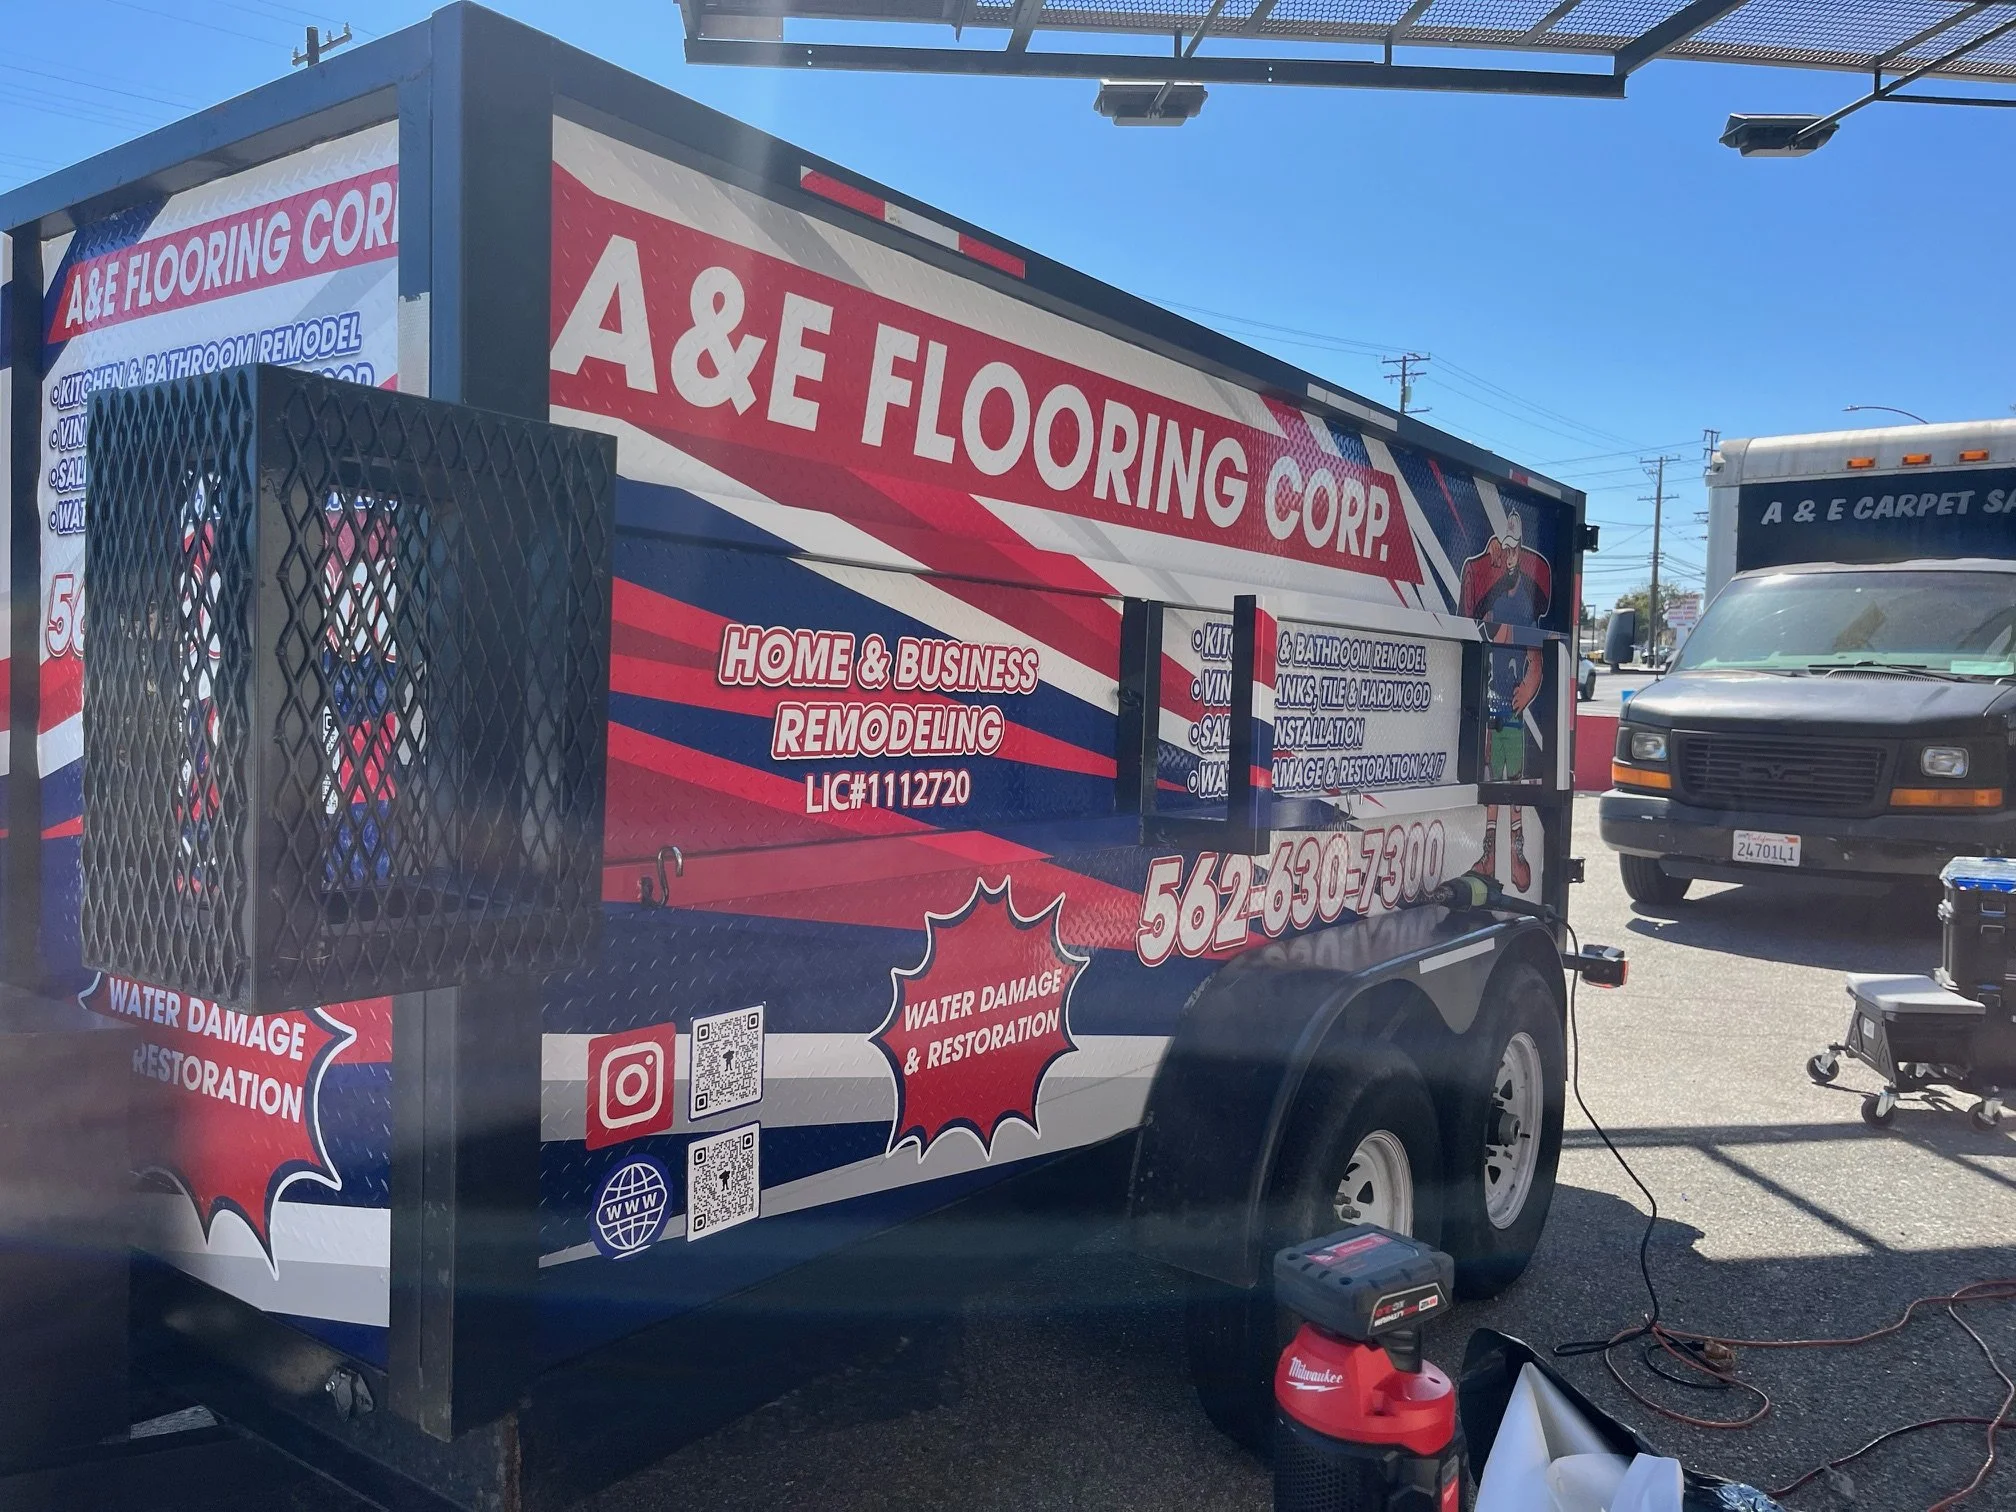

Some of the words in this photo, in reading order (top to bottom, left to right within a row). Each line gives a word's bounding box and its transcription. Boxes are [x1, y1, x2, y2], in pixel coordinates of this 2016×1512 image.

[65, 262, 119, 328] A&E
[125, 211, 291, 311] FLOORING
[126, 358, 141, 388] &
[143, 332, 257, 385] BATHROOM
[258, 311, 362, 366] REMODEL
[549, 235, 834, 431] A&E
[861, 323, 1249, 530] FLOORING
[1265, 455, 1391, 562] CORP.
[1761, 502, 1782, 525] A
[1793, 500, 1816, 523] &
[1827, 498, 1847, 521] E
[1853, 490, 1975, 520] CARPET
[719, 625, 855, 687] HOME
[857, 634, 892, 688] &
[894, 637, 1040, 694] BUSINESS
[1277, 631, 1293, 666] &
[1293, 633, 1372, 671] BATHROOM
[1372, 643, 1427, 675] REMODEL
[1319, 676, 1347, 710] TILE
[1347, 678, 1359, 709] &
[1359, 680, 1431, 711] HARDWOOD
[771, 702, 1005, 760] REMODELING
[805, 769, 972, 815] LIC#1112720
[1325, 757, 1338, 790] &
[1338, 754, 1420, 788] RESTORATION
[1419, 752, 1447, 783] 24/7
[1136, 819, 1446, 967] 562-630-7300
[109, 977, 180, 1029] WATER
[187, 998, 306, 1061] DAMAGE
[903, 990, 974, 1032] WATER
[978, 968, 1063, 1014] DAMAGE
[903, 1047, 921, 1076] &
[925, 1008, 1061, 1071] RESTORATION
[1288, 1356, 1344, 1384] Milwaukee
